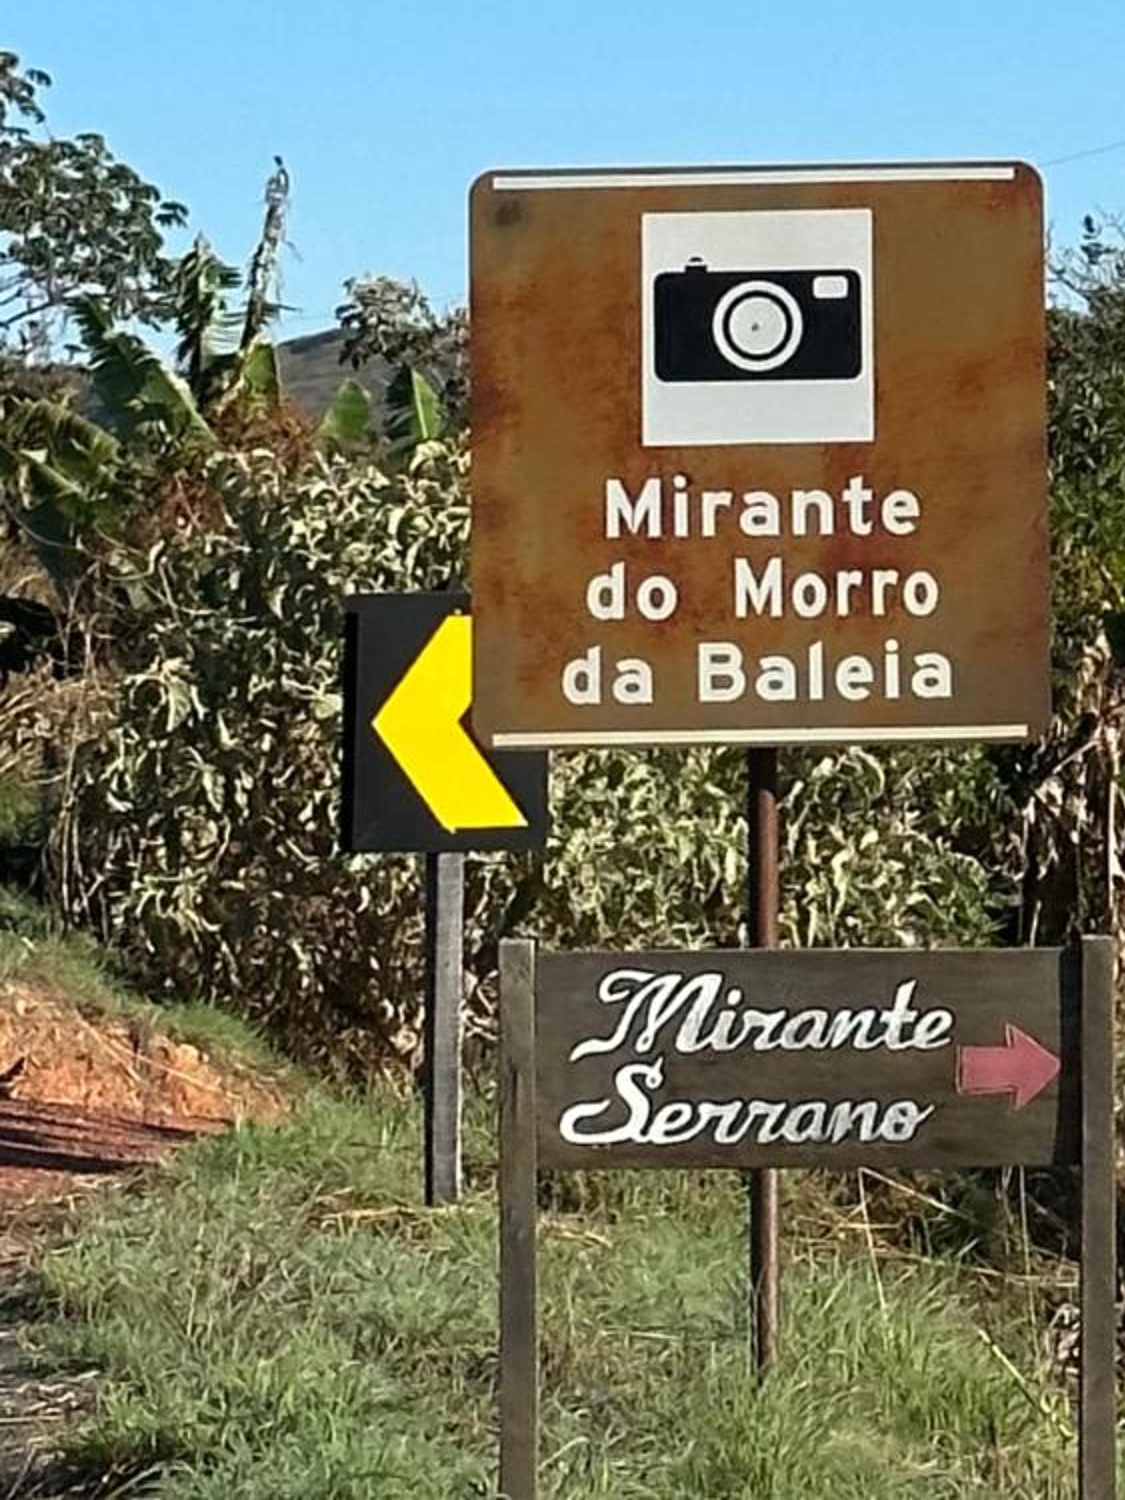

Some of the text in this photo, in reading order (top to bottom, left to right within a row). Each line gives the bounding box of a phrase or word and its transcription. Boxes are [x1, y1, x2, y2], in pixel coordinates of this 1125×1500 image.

[604, 475, 922, 540] Mirante
[585, 556, 940, 623] do Morro
[561, 638, 953, 706] da Baleia
[568, 968, 954, 1062] Mirante
[559, 1056, 935, 1145] Serrano
